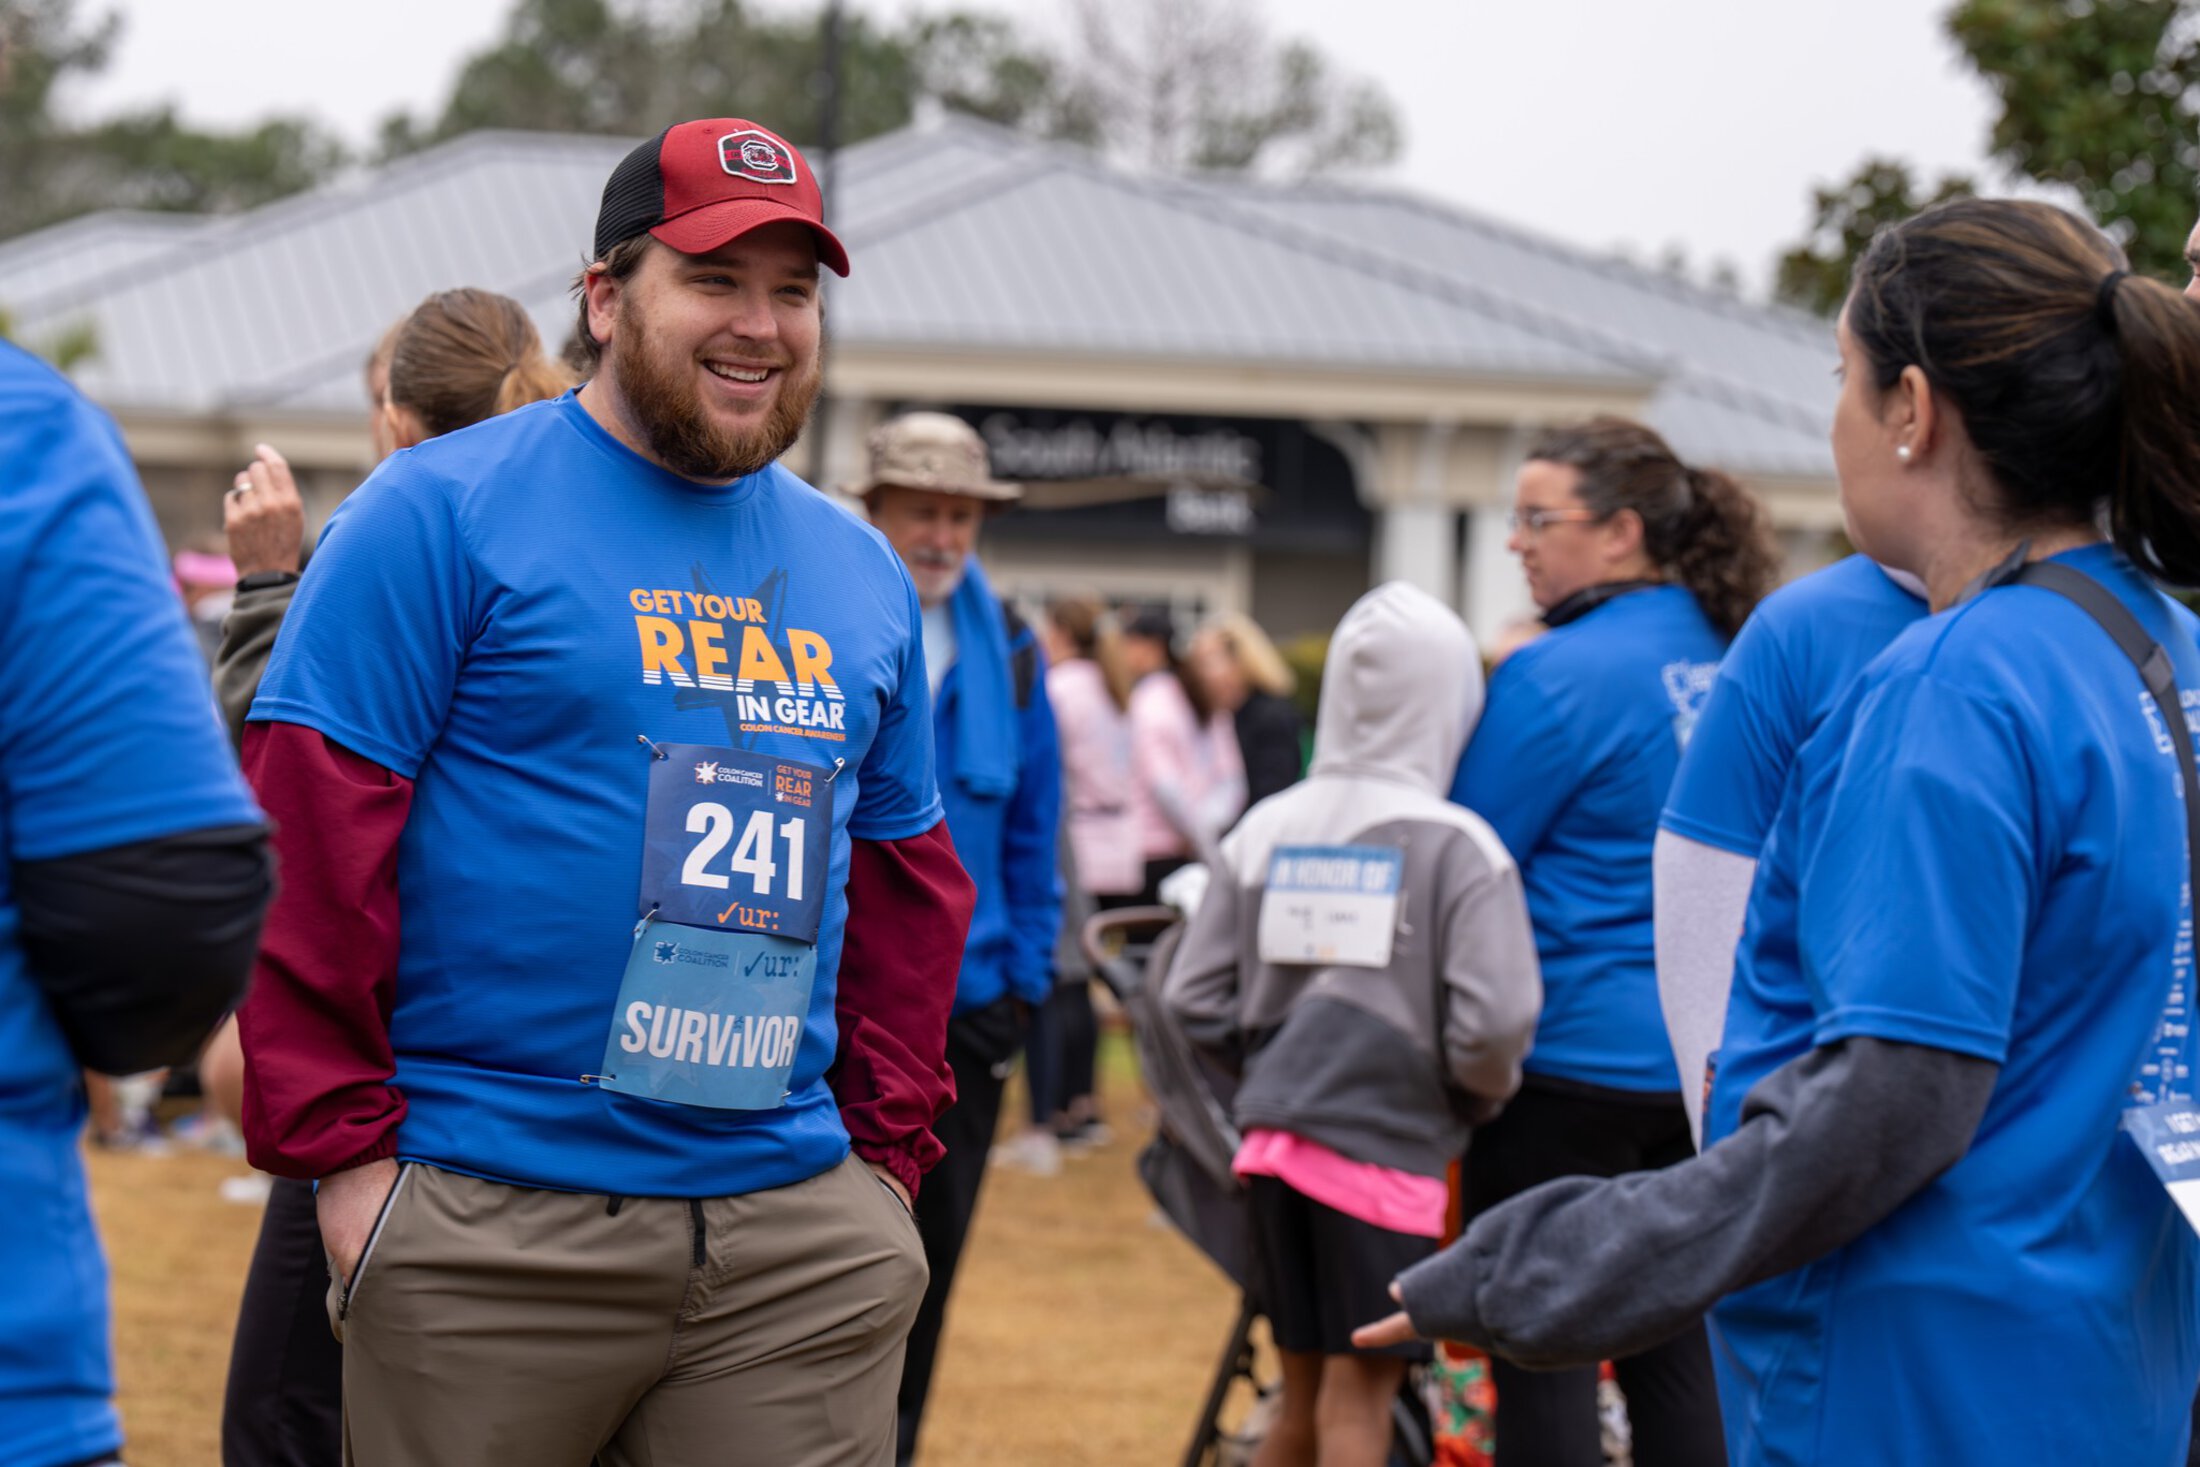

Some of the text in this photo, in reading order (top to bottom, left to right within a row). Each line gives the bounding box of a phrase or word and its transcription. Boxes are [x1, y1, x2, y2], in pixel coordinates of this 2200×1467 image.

[629, 588, 768, 624] GET YOUR
[634, 615, 846, 700] REAR
[736, 695, 846, 731] IN GEAR
[740, 723, 773, 733] COLON
[773, 725, 803, 737] CANCER
[717, 774, 812, 798] COALITION REAR
[777, 765, 792, 774] GET
[793, 767, 812, 779] YOUR
[681, 802, 805, 901] 241
[1295, 857, 1360, 888] HONOR
[1363, 860, 1395, 891] OF
[677, 953, 729, 969] COALITION
